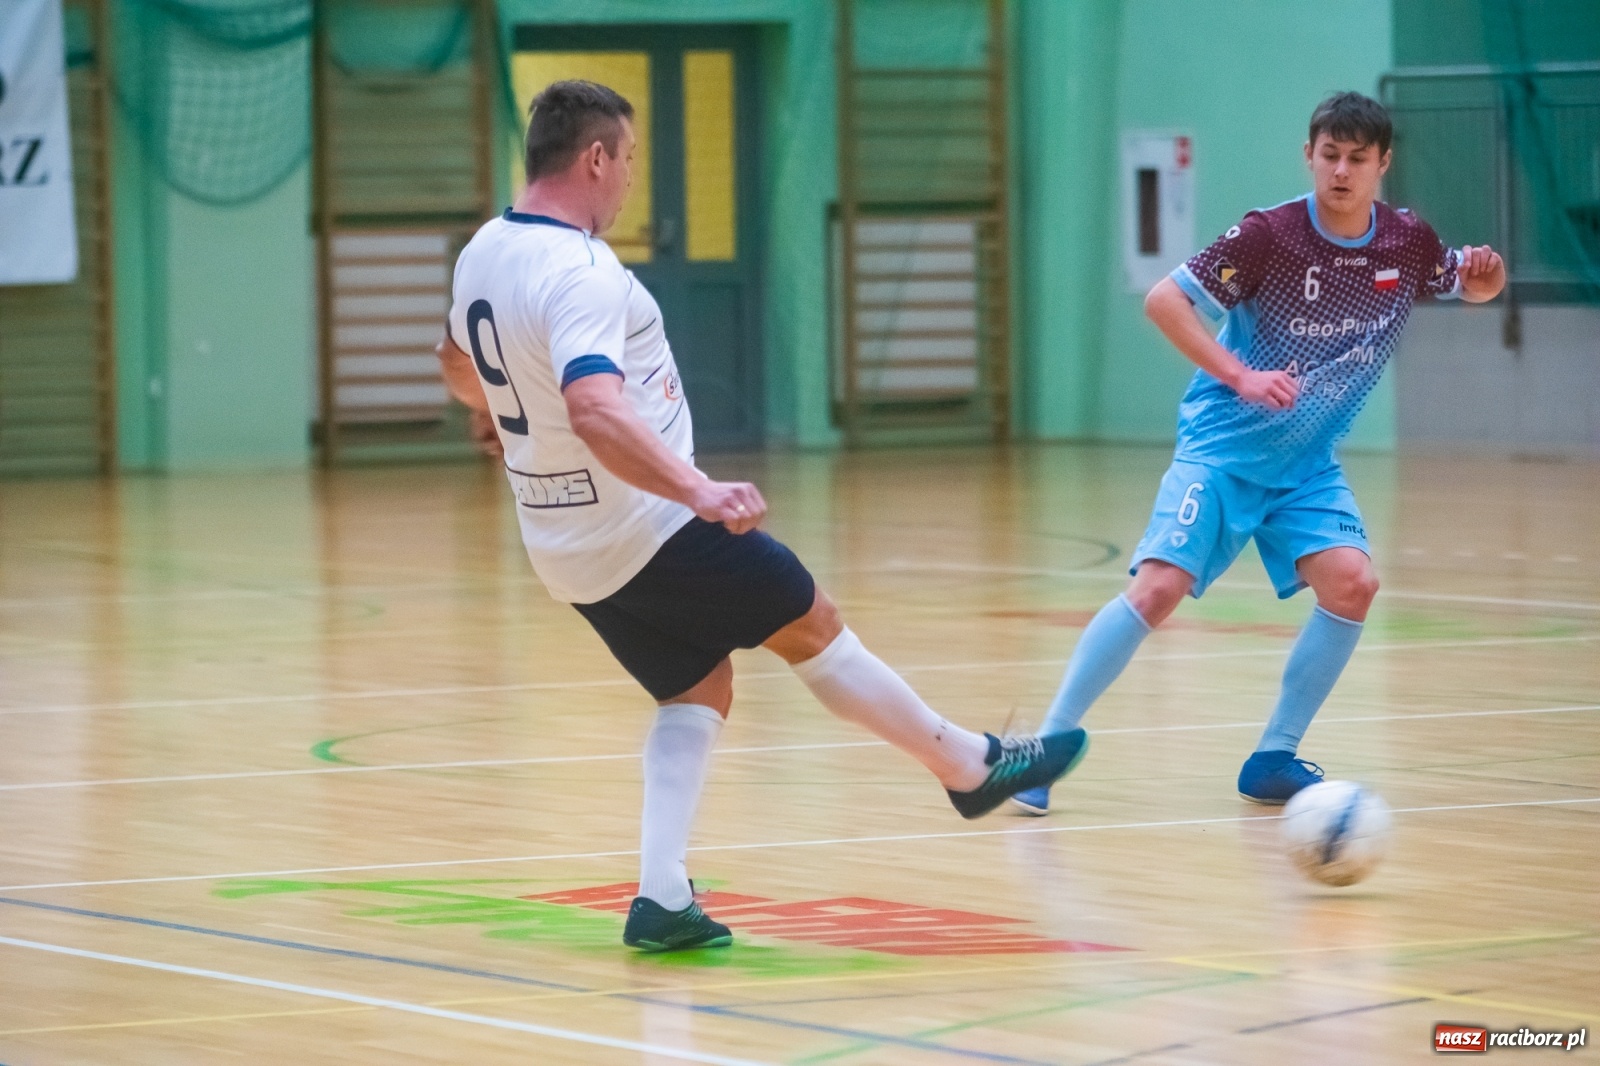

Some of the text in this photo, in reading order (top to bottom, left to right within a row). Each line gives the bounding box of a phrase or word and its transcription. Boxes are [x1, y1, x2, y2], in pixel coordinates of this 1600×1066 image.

[1303, 265, 1321, 301] 6
[466, 298, 529, 436] 9
[1177, 481, 1206, 527] 6
